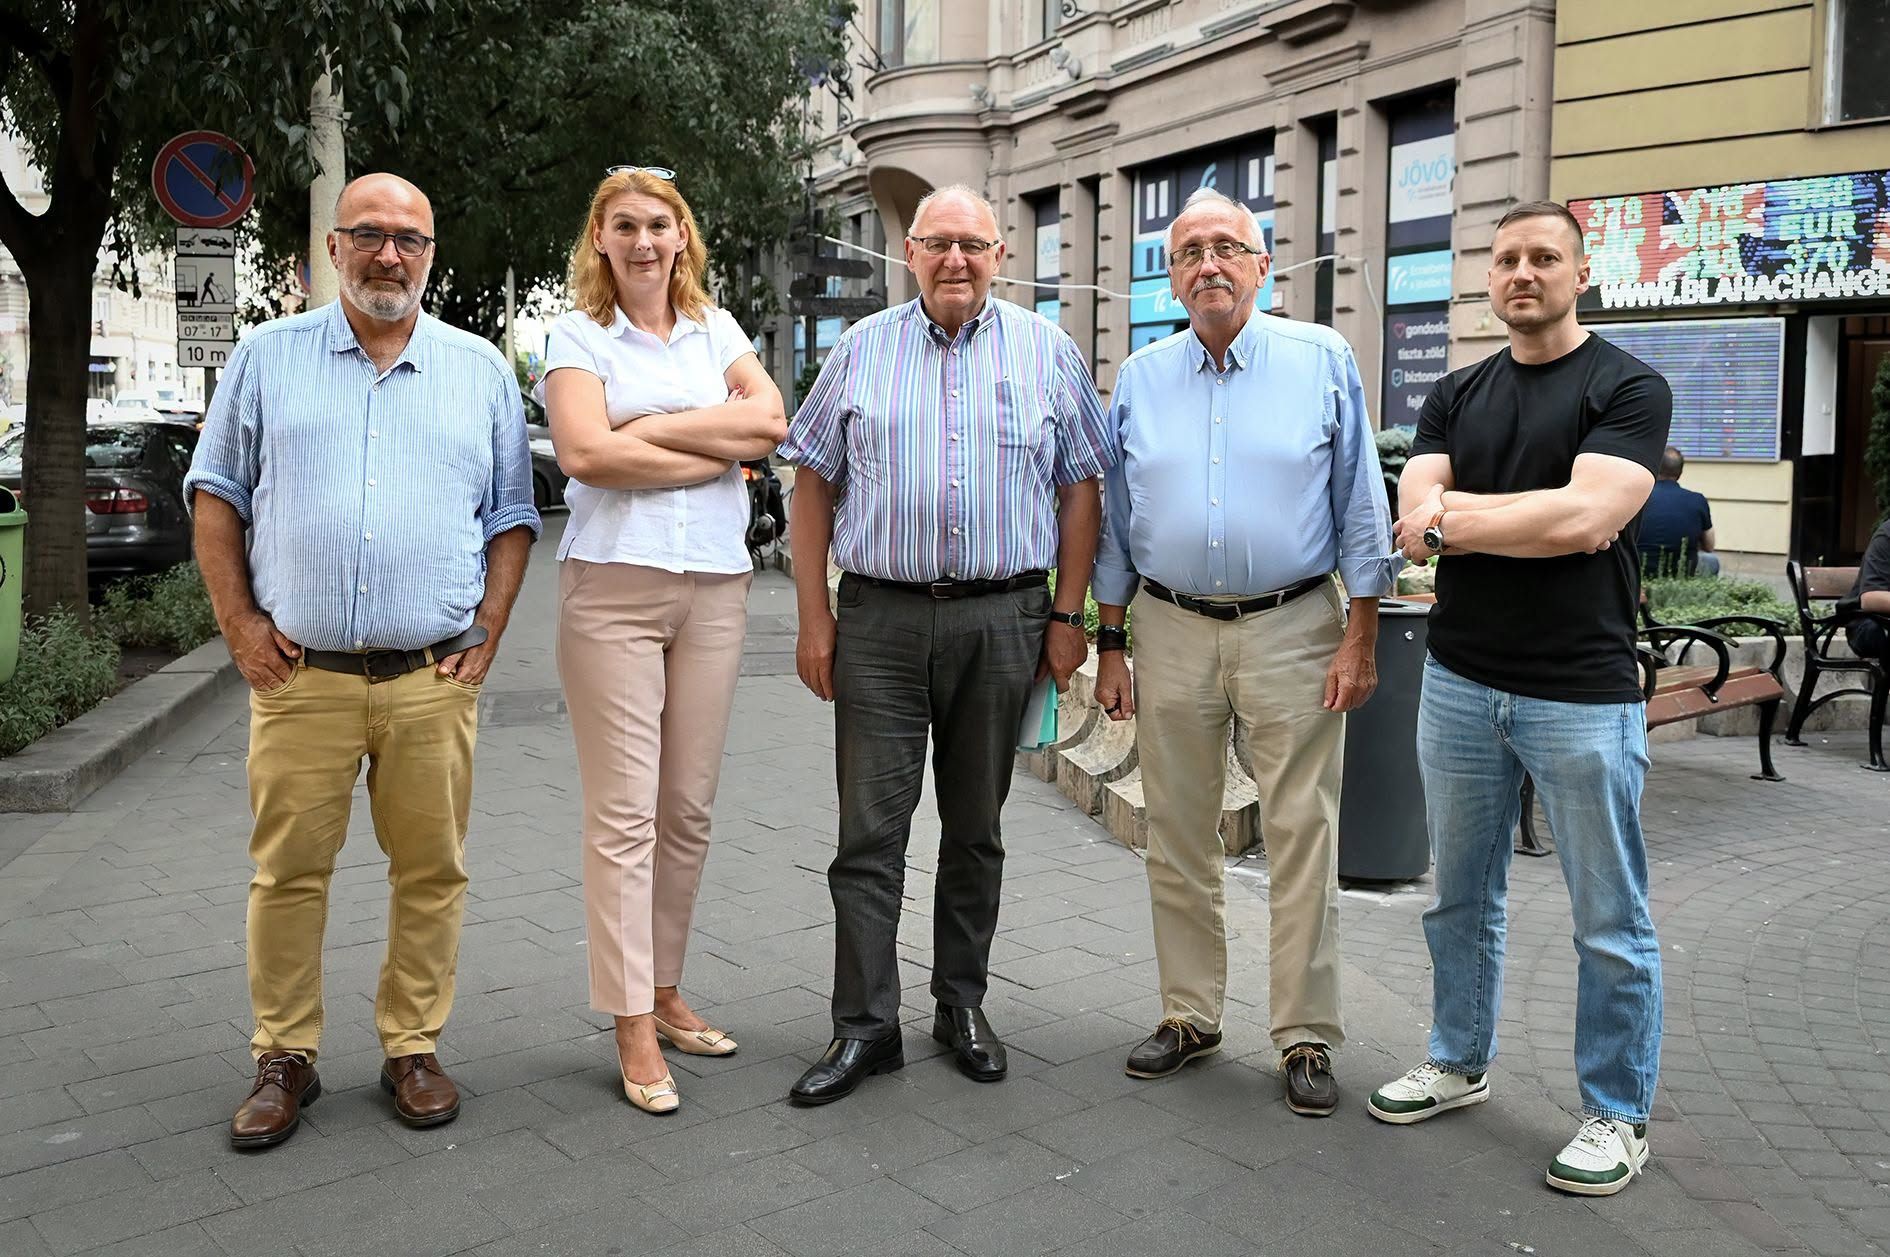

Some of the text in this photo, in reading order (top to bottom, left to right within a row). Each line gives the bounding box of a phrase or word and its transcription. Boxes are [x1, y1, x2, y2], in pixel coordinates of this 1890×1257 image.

[1587, 196, 1643, 227] 378
[1779, 210, 1856, 240] EUR
[1783, 240, 1849, 274] 370
[184, 326, 198, 337] 07
[210, 326, 222, 337] 17
[187, 346, 226, 362] 10 m
